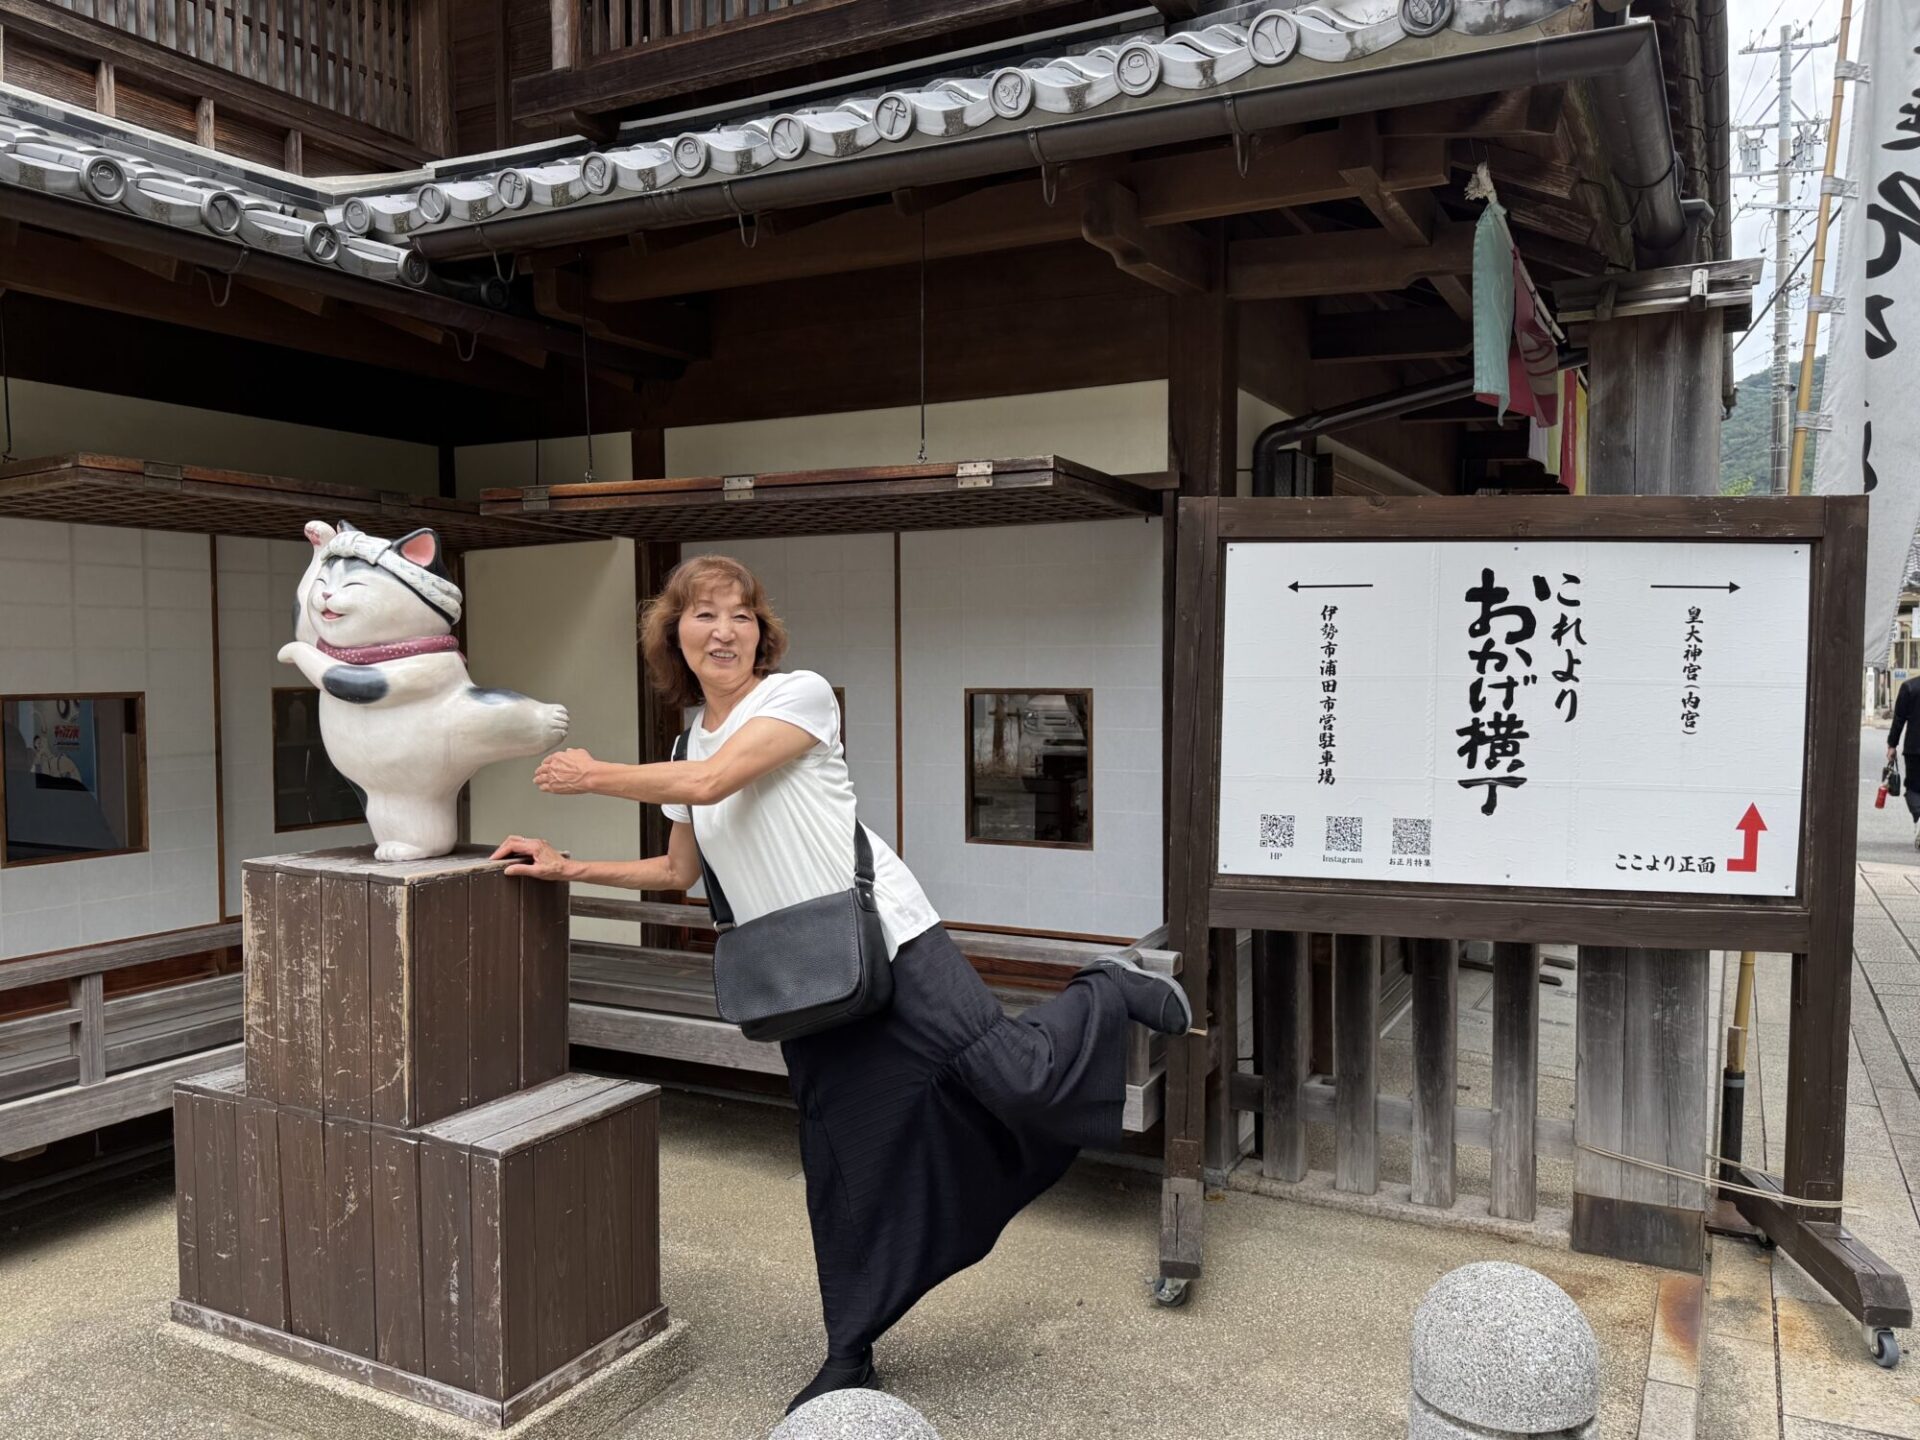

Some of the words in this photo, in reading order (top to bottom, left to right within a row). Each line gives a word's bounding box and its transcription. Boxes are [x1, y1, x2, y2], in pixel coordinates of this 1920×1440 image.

[1550, 572, 1588, 723] これより
[1317, 604, 1339, 786] 伊勢市浦田市営駐車場
[1455, 567, 1552, 817] おかげ横丁
[1270, 851, 1283, 860] HP
[1322, 854, 1363, 864] Instagram
[1615, 853, 1716, 874] ここより正面
